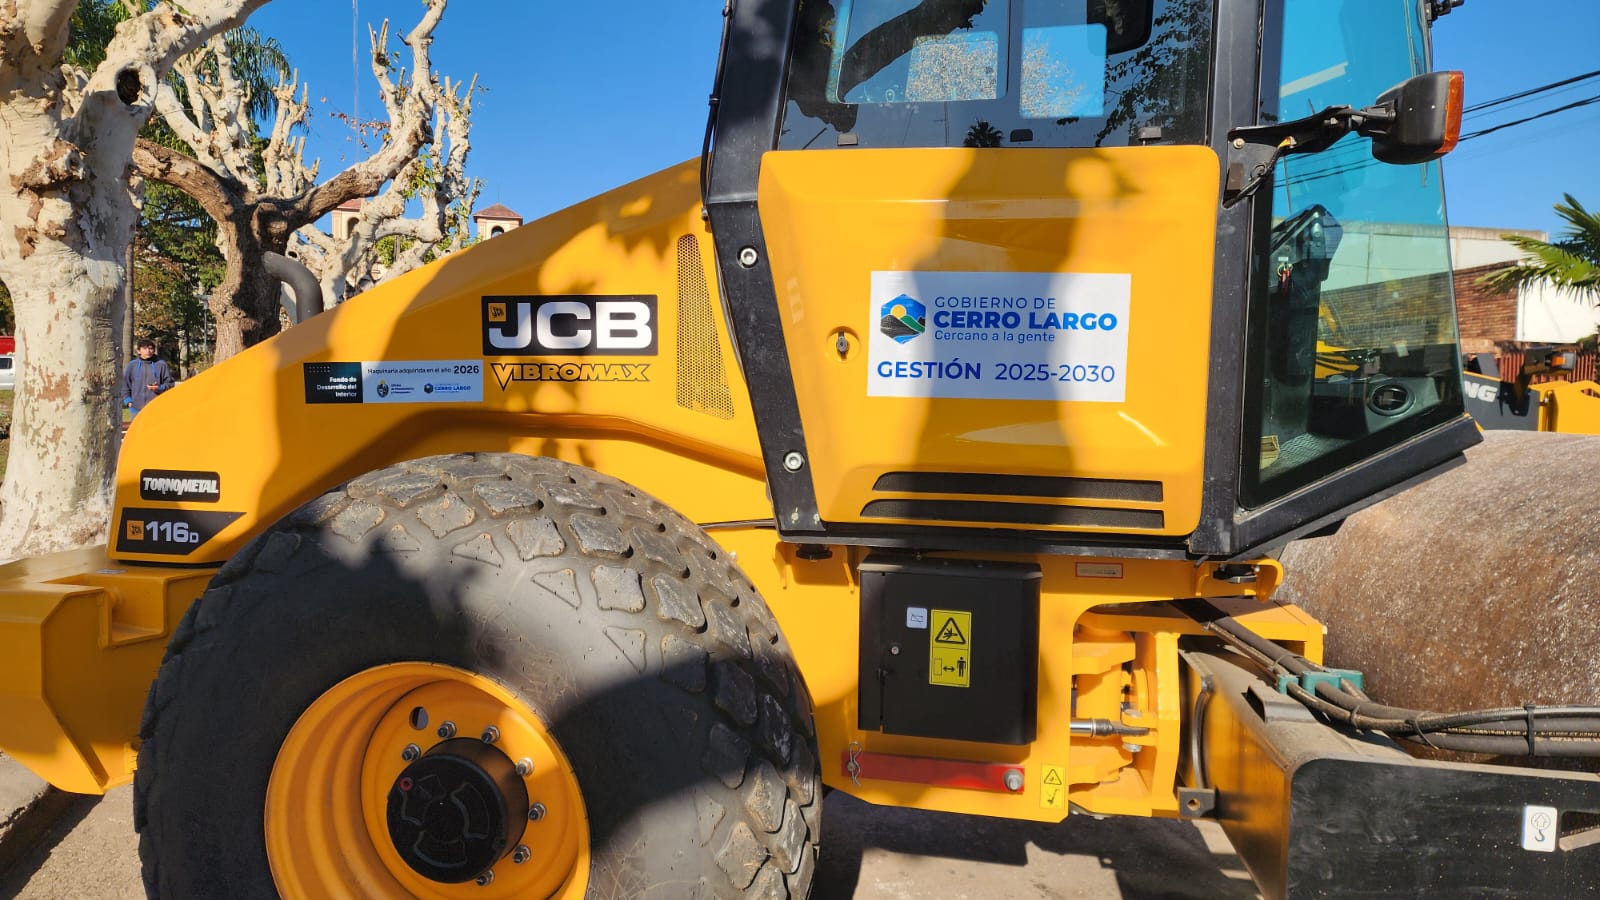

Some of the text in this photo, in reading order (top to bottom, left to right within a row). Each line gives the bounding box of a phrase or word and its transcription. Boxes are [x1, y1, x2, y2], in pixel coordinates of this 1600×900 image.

[934, 296, 1056, 310] GOBIERNO DE
[488, 301, 652, 349] JCB
[933, 310, 1118, 331] CERRO LARGO
[934, 330, 1056, 344] Cercano a la gente
[399, 367, 426, 375] adquirida
[453, 365, 480, 374] 2026
[491, 362, 651, 392] VIBROMAX
[877, 358, 1116, 383] GESTIÓN 2025-2030
[142, 477, 219, 496] TORNOMETAL
[145, 520, 200, 544] 116D
